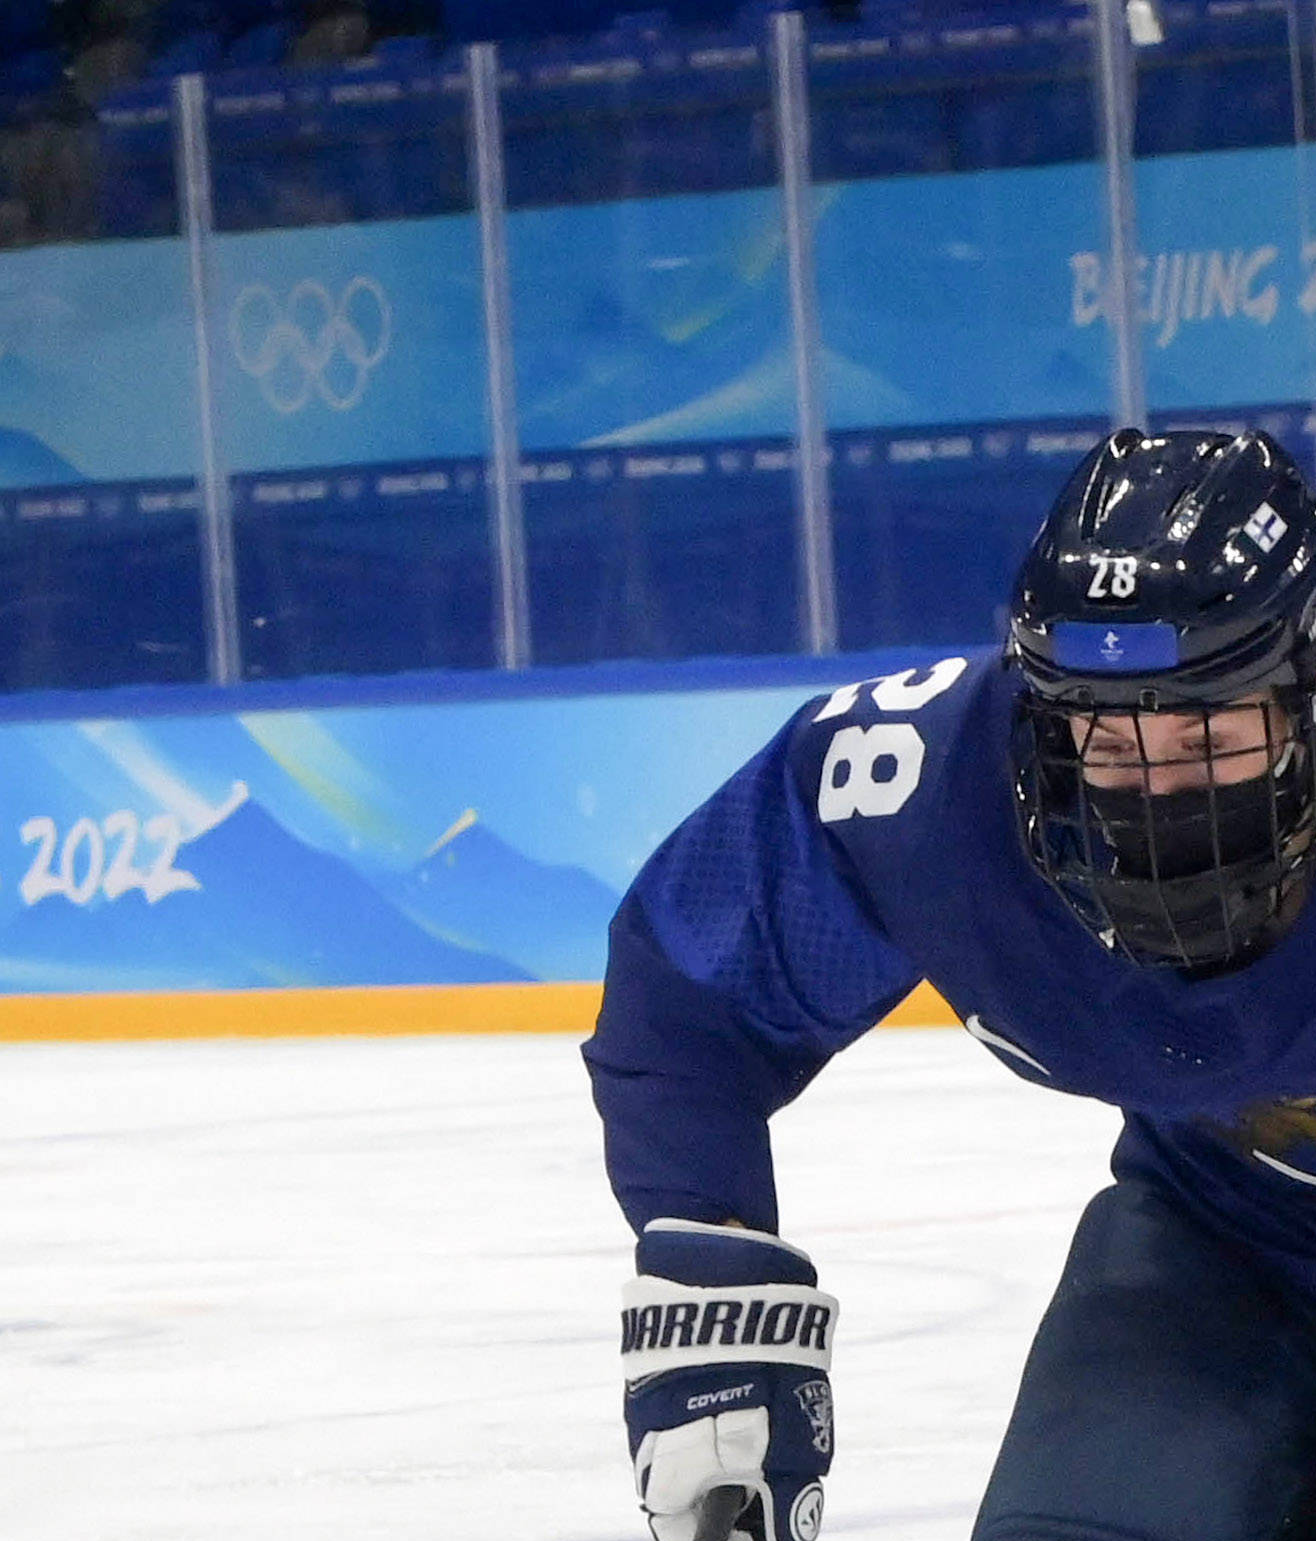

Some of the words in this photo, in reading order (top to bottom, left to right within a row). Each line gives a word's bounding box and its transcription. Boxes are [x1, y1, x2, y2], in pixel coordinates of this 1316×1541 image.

[1087, 555, 1138, 598] 28
[19, 810, 201, 905] 2022
[686, 1383, 754, 1411] COVERT
